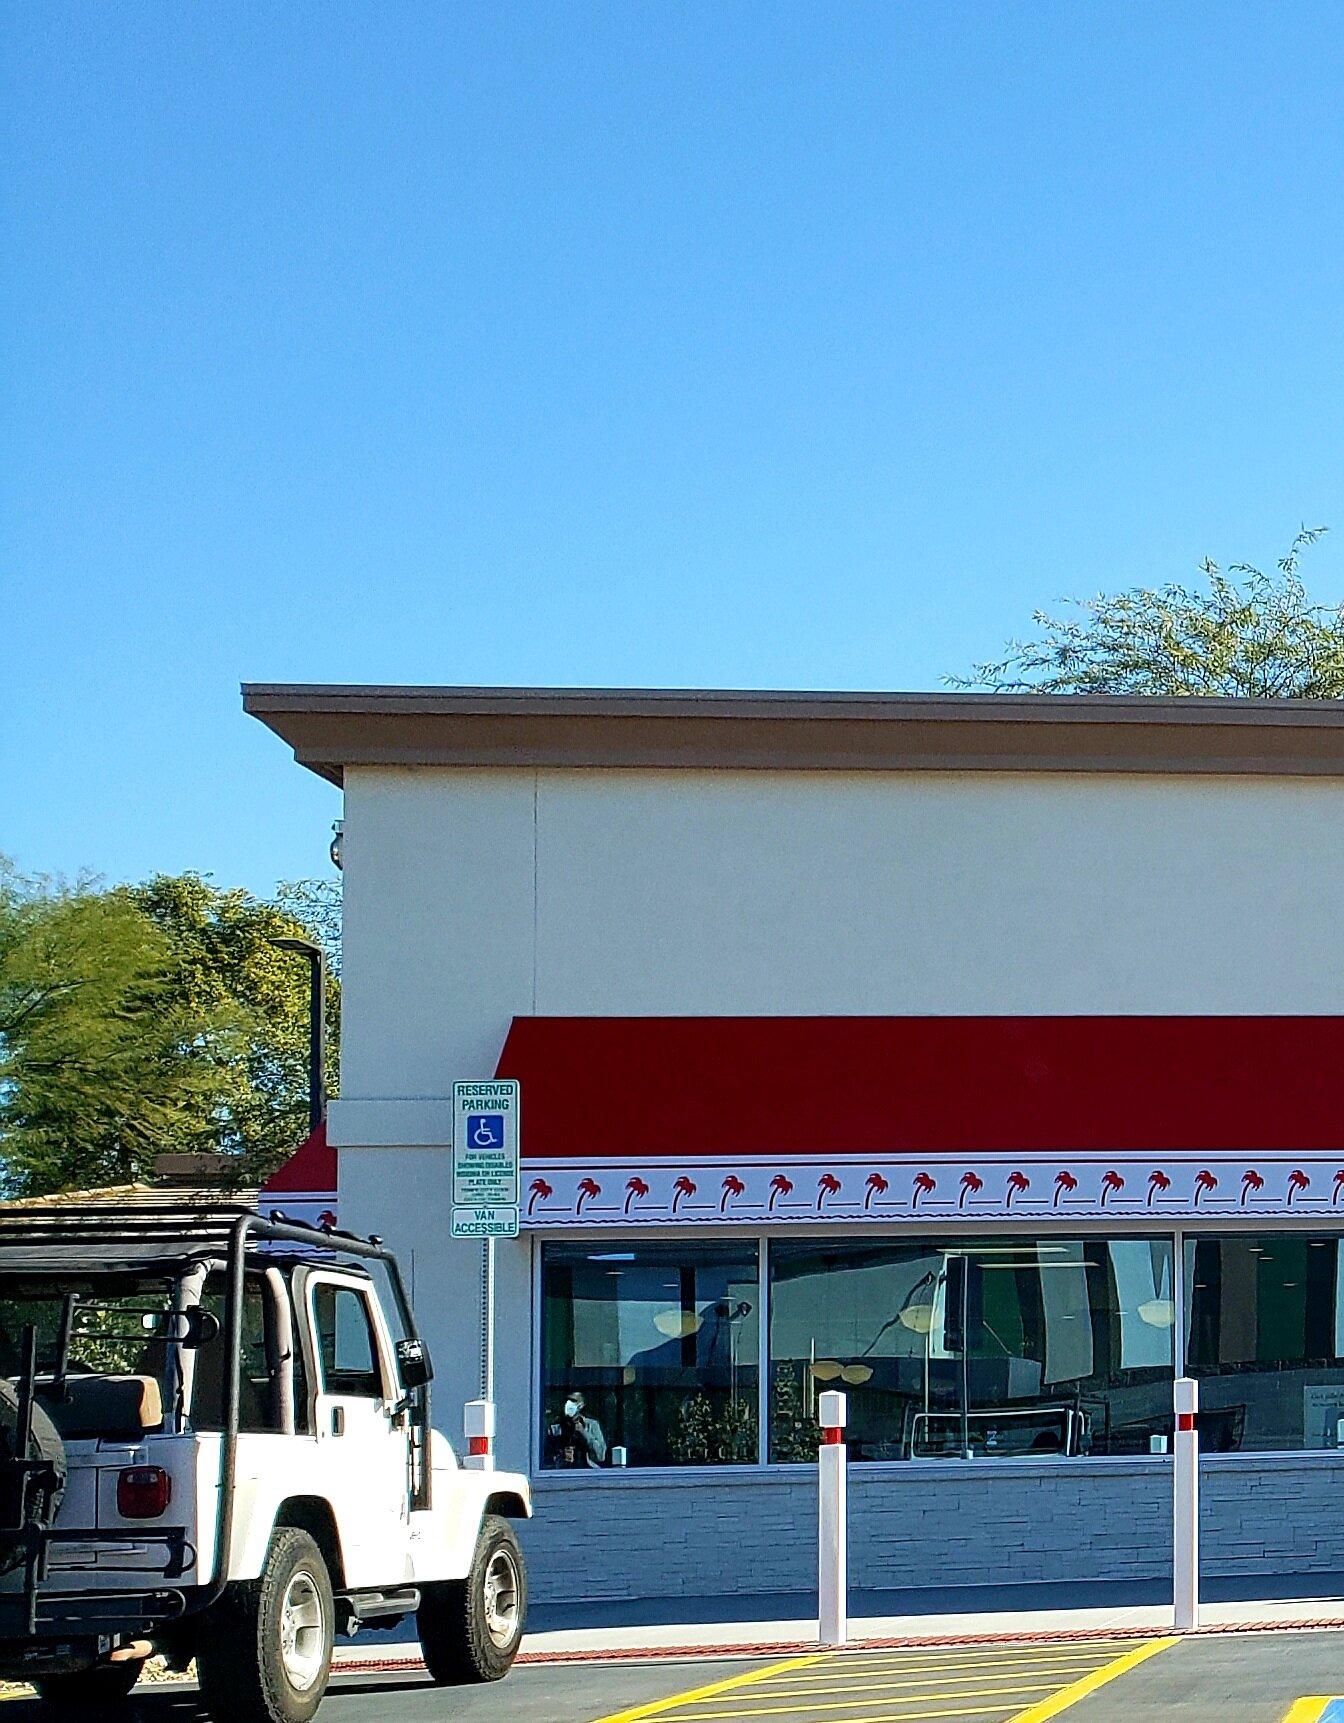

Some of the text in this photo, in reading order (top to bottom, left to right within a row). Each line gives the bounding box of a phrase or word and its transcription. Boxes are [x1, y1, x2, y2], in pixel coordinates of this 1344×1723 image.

[457, 1084, 514, 1096] RESERVED
[462, 1098, 510, 1111] PARKING
[474, 1210, 495, 1221] VAN
[455, 1222, 515, 1234] ACCESSIBLE
